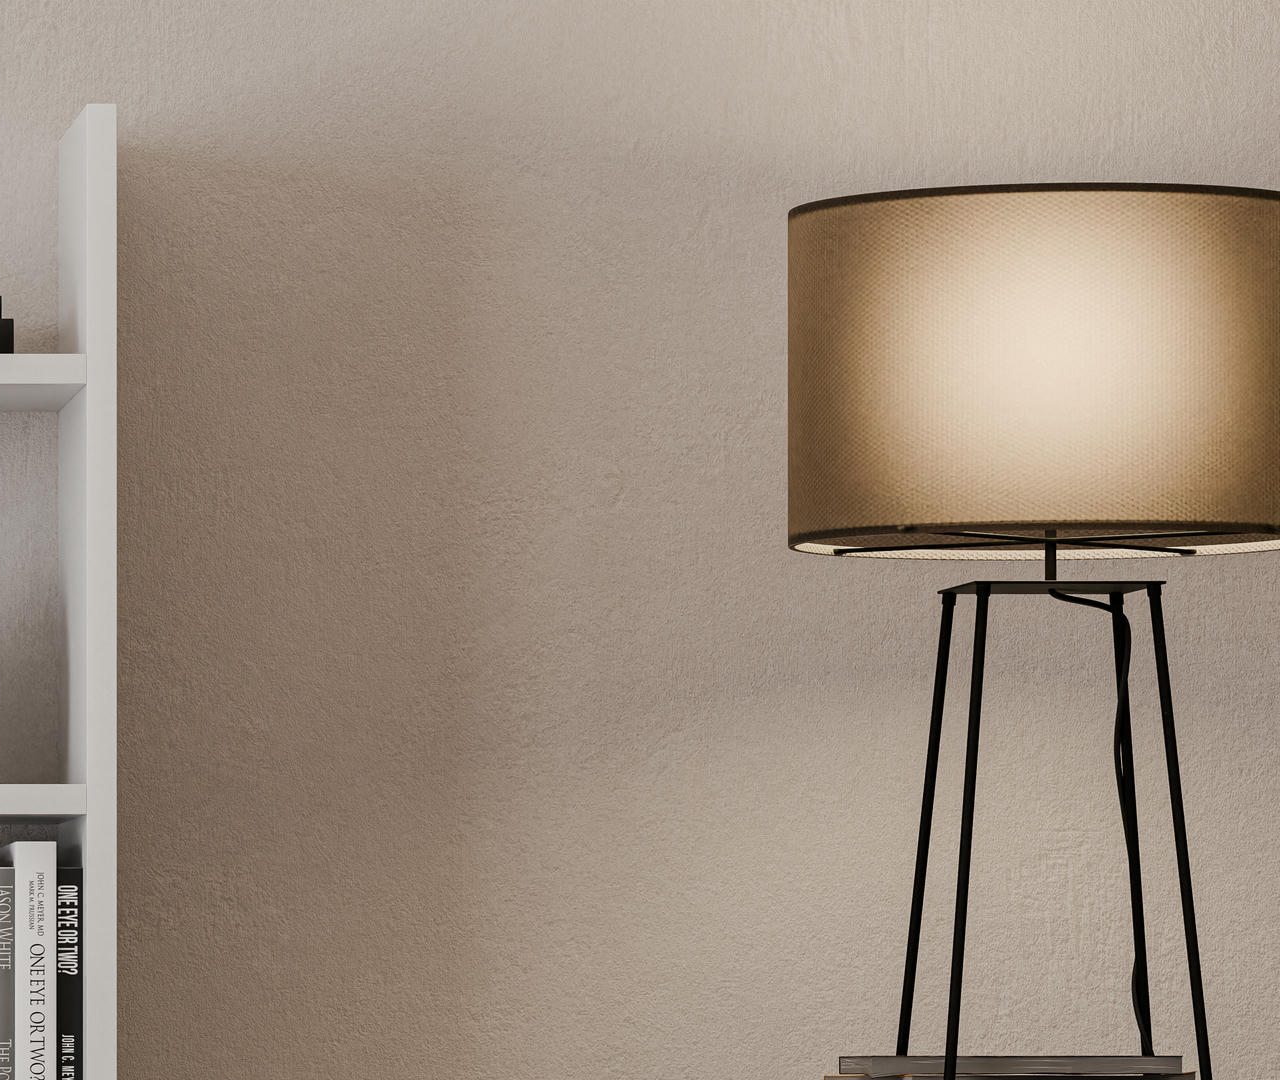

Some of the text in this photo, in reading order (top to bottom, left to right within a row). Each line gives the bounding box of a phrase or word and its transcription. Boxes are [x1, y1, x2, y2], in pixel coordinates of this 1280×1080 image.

[58, 885, 78, 976] ONE EYE OR TWO?
[30, 943, 45, 1080] ONE EYE OR TWO?
[61, 1034, 75, 1056] JOHN
